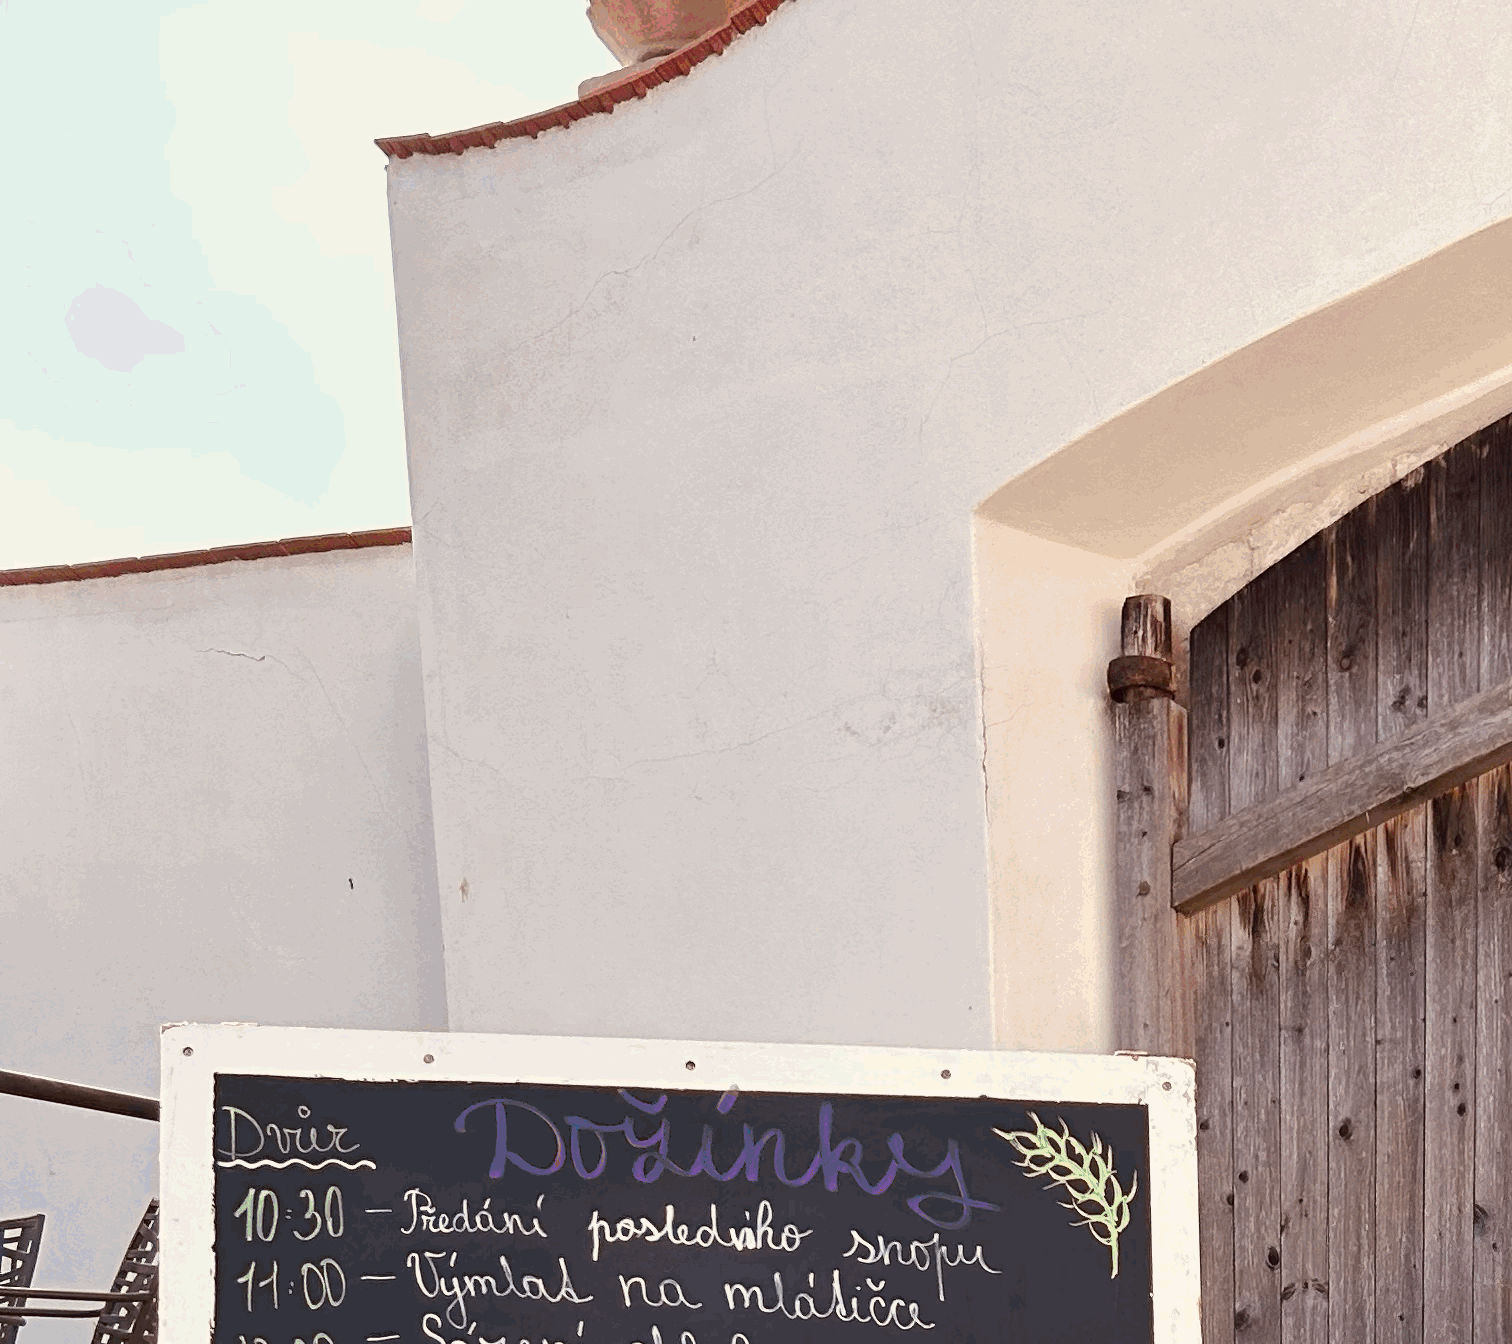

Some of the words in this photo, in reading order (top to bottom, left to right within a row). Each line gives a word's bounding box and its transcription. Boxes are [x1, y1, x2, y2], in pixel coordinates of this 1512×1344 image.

[218, 1106, 359, 1159] Dvůr
[455, 1084, 1000, 1229] Dožínky
[235, 1187, 343, 1241] 10:30
[401, 1187, 547, 1237] Předání
[843, 1230, 1002, 1300] snopu
[237, 1258, 346, 1311] 11:00
[407, 1251, 593, 1328] Výmlat
[620, 1274, 702, 1308] na
[725, 1269, 935, 1329] mlátičce
